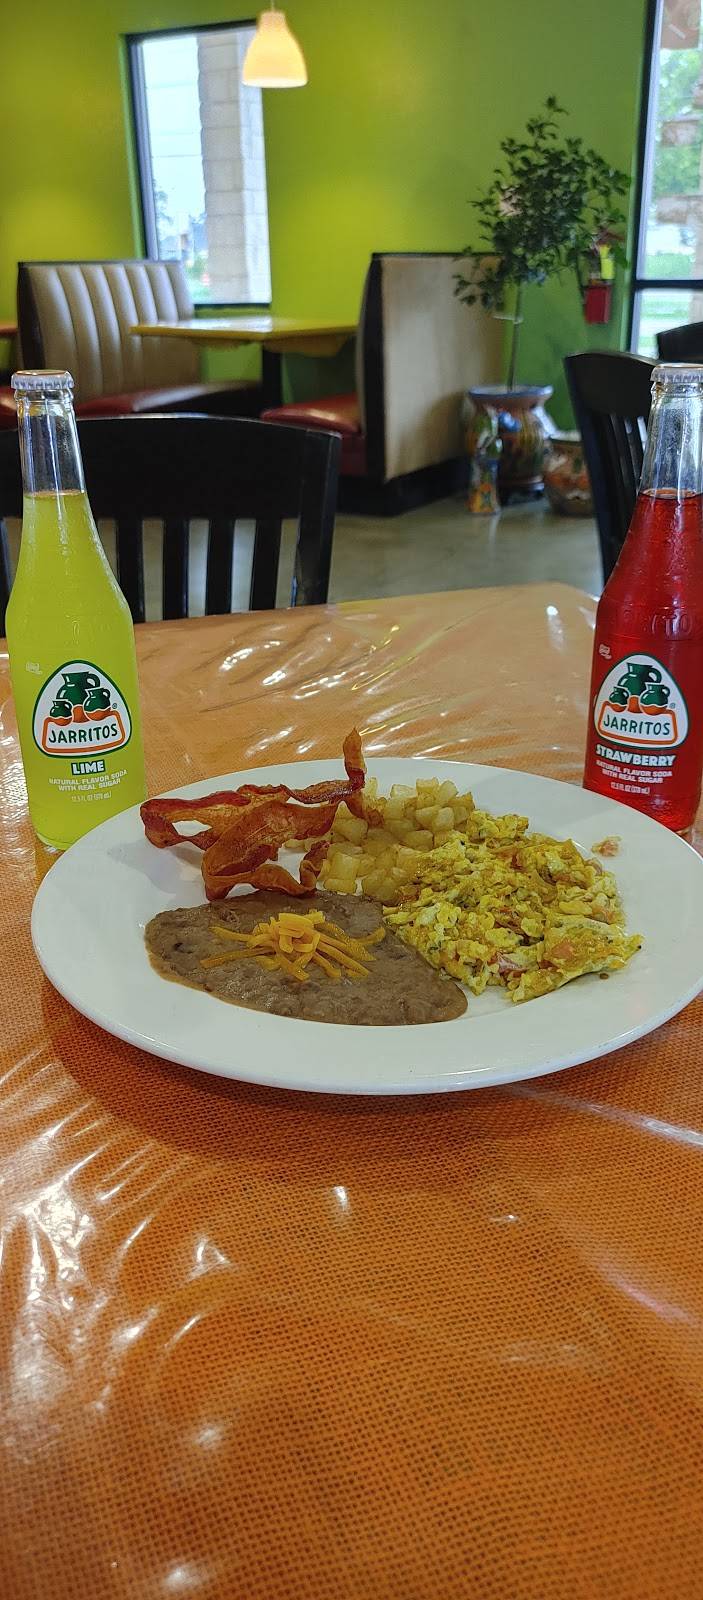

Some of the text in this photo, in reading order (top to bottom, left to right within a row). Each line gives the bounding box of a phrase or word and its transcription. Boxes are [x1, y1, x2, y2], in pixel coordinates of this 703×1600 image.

[604, 714, 671, 735] JARRITOS
[48, 723, 118, 743] JARRITOS
[596, 744, 677, 766] STRAWBERRY
[72, 760, 105, 775] LIME
[623, 768, 651, 777] FLAVOR
[82, 775, 110, 784] FLAVOR
[111, 770, 128, 780] SODA
[98, 778, 120, 788] SUGAR
